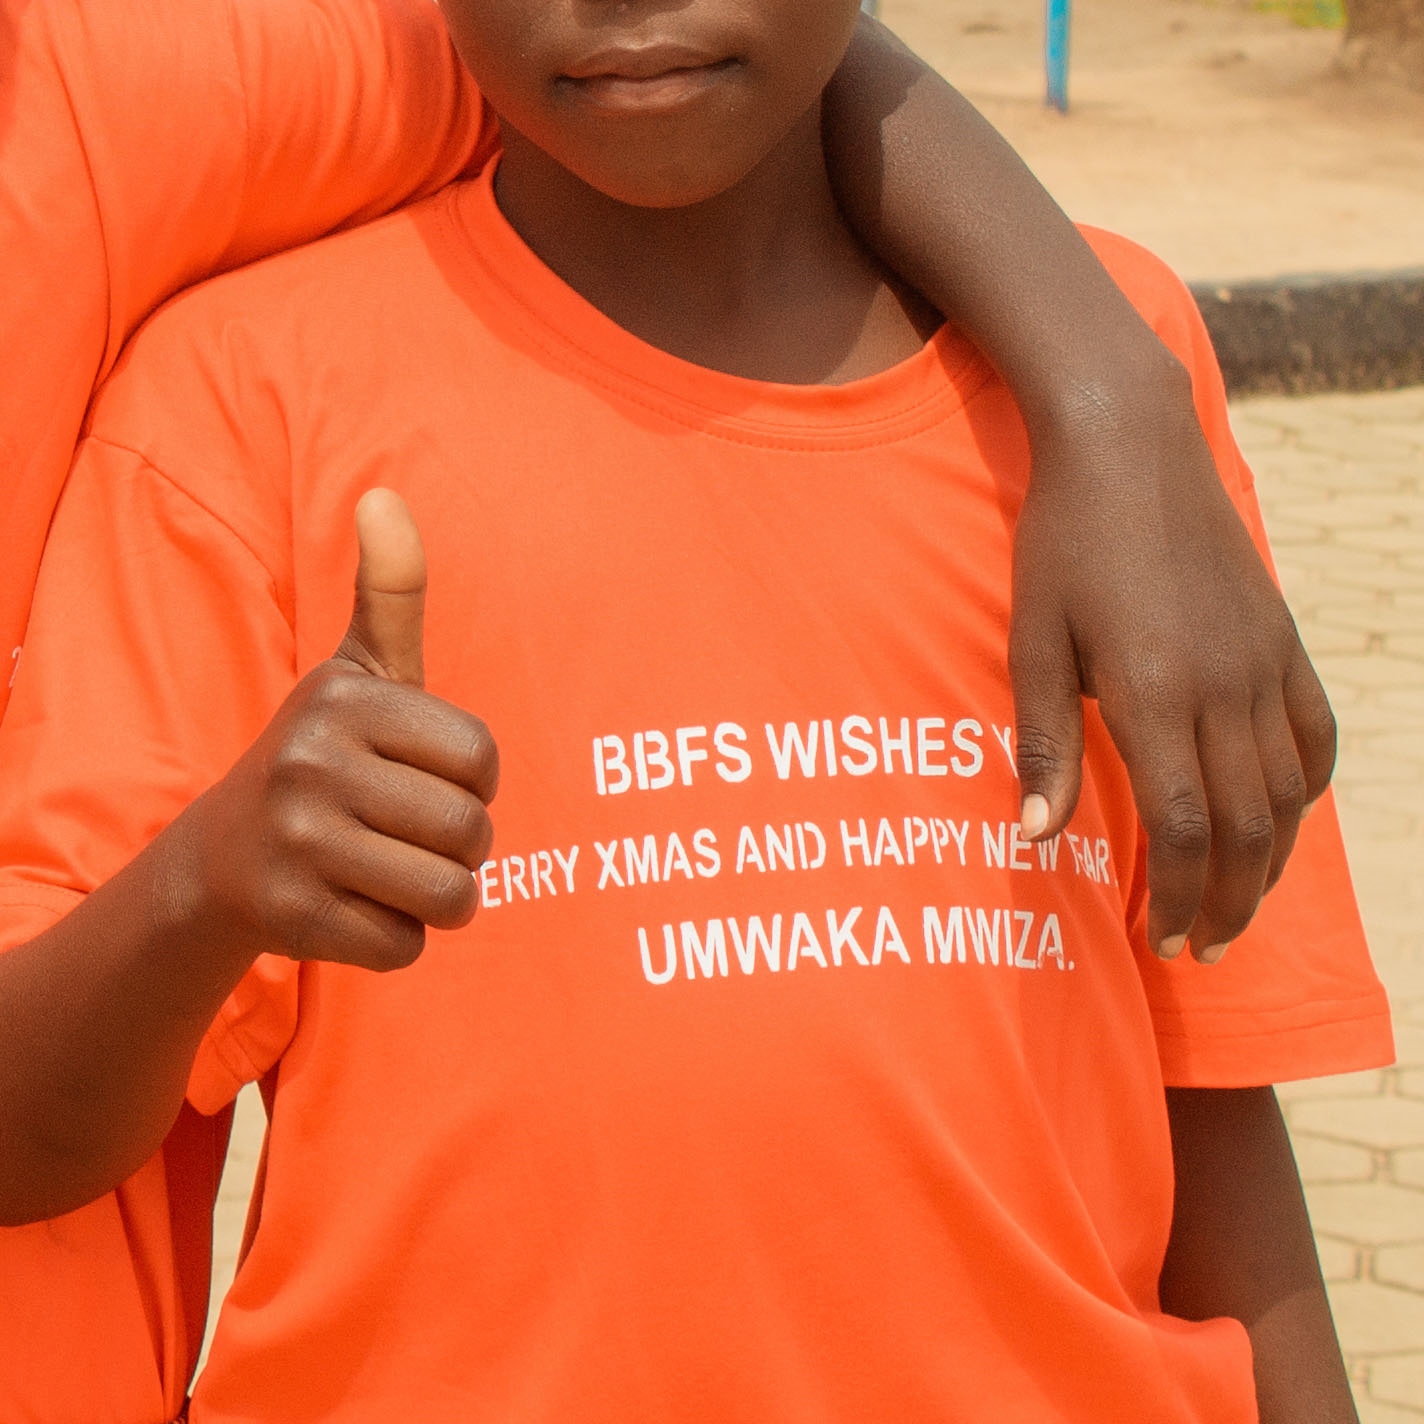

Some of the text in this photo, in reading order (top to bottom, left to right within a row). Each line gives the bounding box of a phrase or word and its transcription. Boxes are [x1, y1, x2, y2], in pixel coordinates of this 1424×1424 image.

[591, 720, 753, 797] BBFS
[763, 713, 984, 784] WISHES
[470, 844, 580, 909] ERRY
[593, 827, 722, 891] XMAS
[735, 820, 827, 875] AND
[838, 815, 970, 868] HAPPY
[981, 820, 1061, 872] NEW
[636, 905, 1076, 986] UMWAKA MWIZA.
